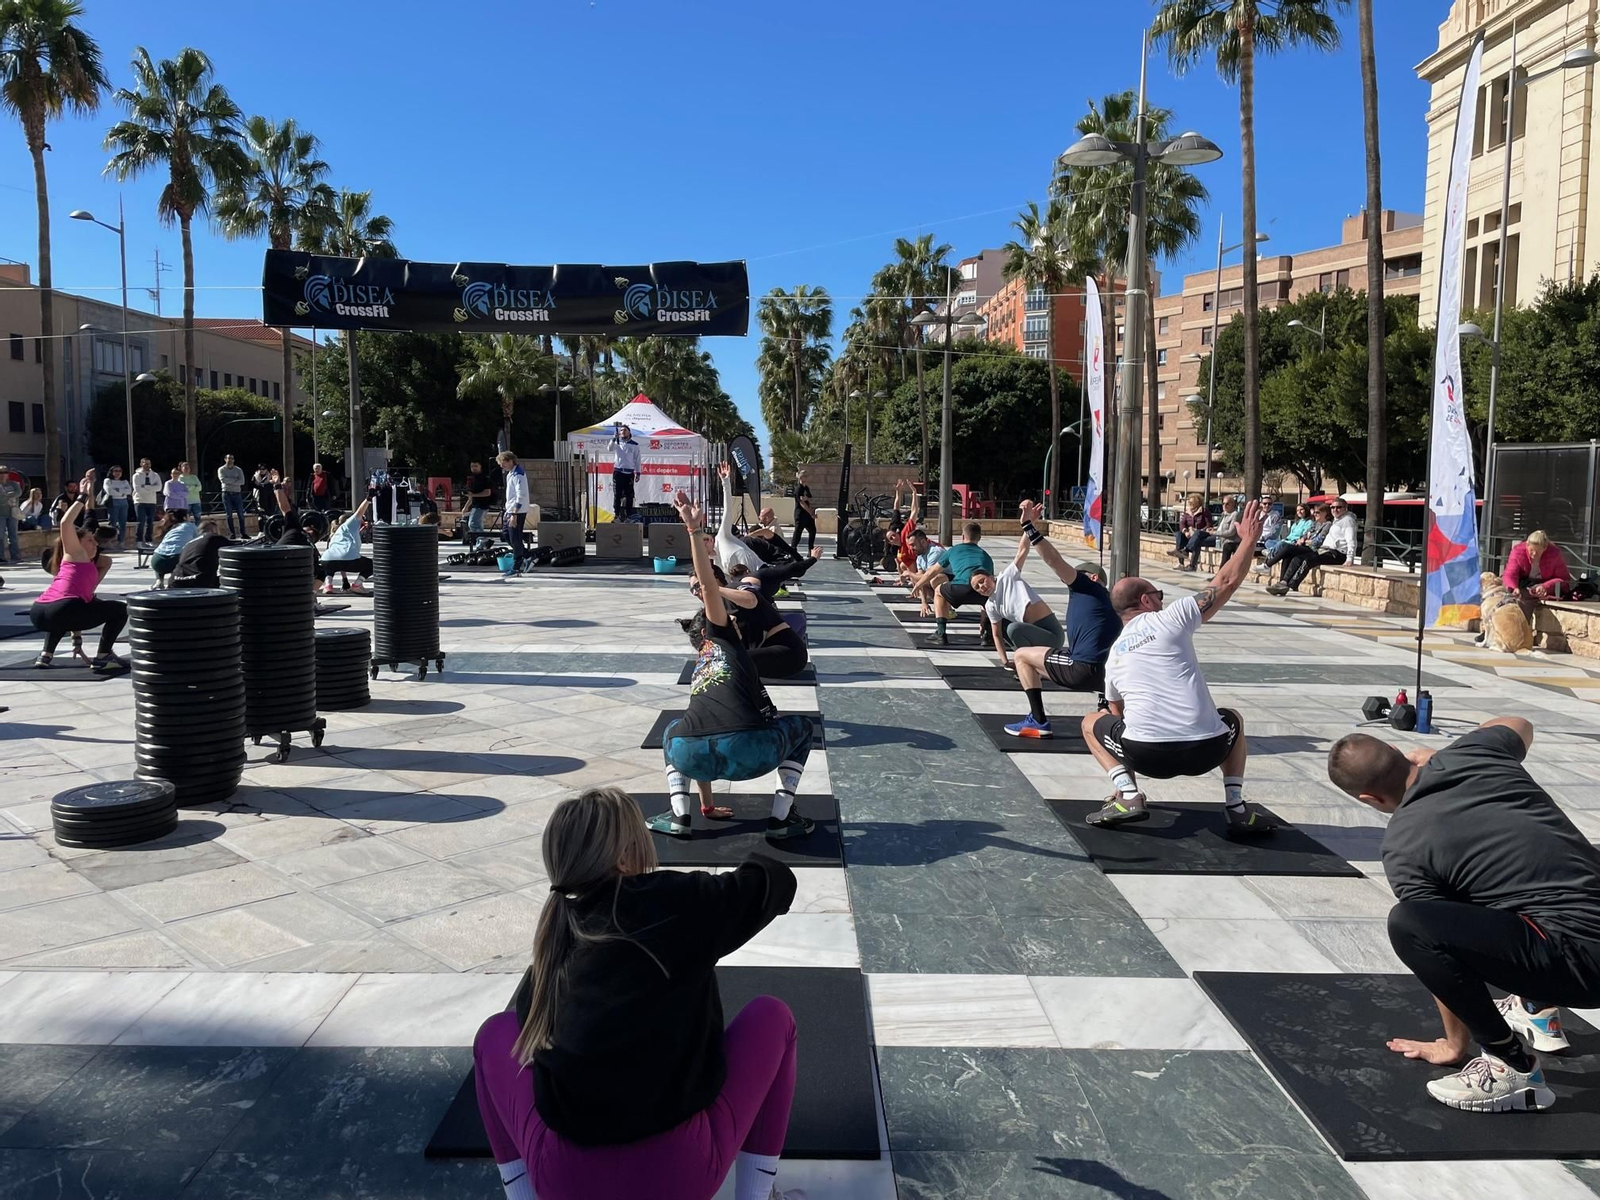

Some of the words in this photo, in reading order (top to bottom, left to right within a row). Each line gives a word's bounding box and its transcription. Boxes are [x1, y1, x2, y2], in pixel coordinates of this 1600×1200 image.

[333, 284, 395, 305] DISEA
[493, 289, 557, 309] DISEA
[656, 290, 718, 309] DISEA
[335, 303, 390, 318] CrossFit
[494, 308, 550, 321] CrossFit
[656, 309, 711, 322] CrossFit
